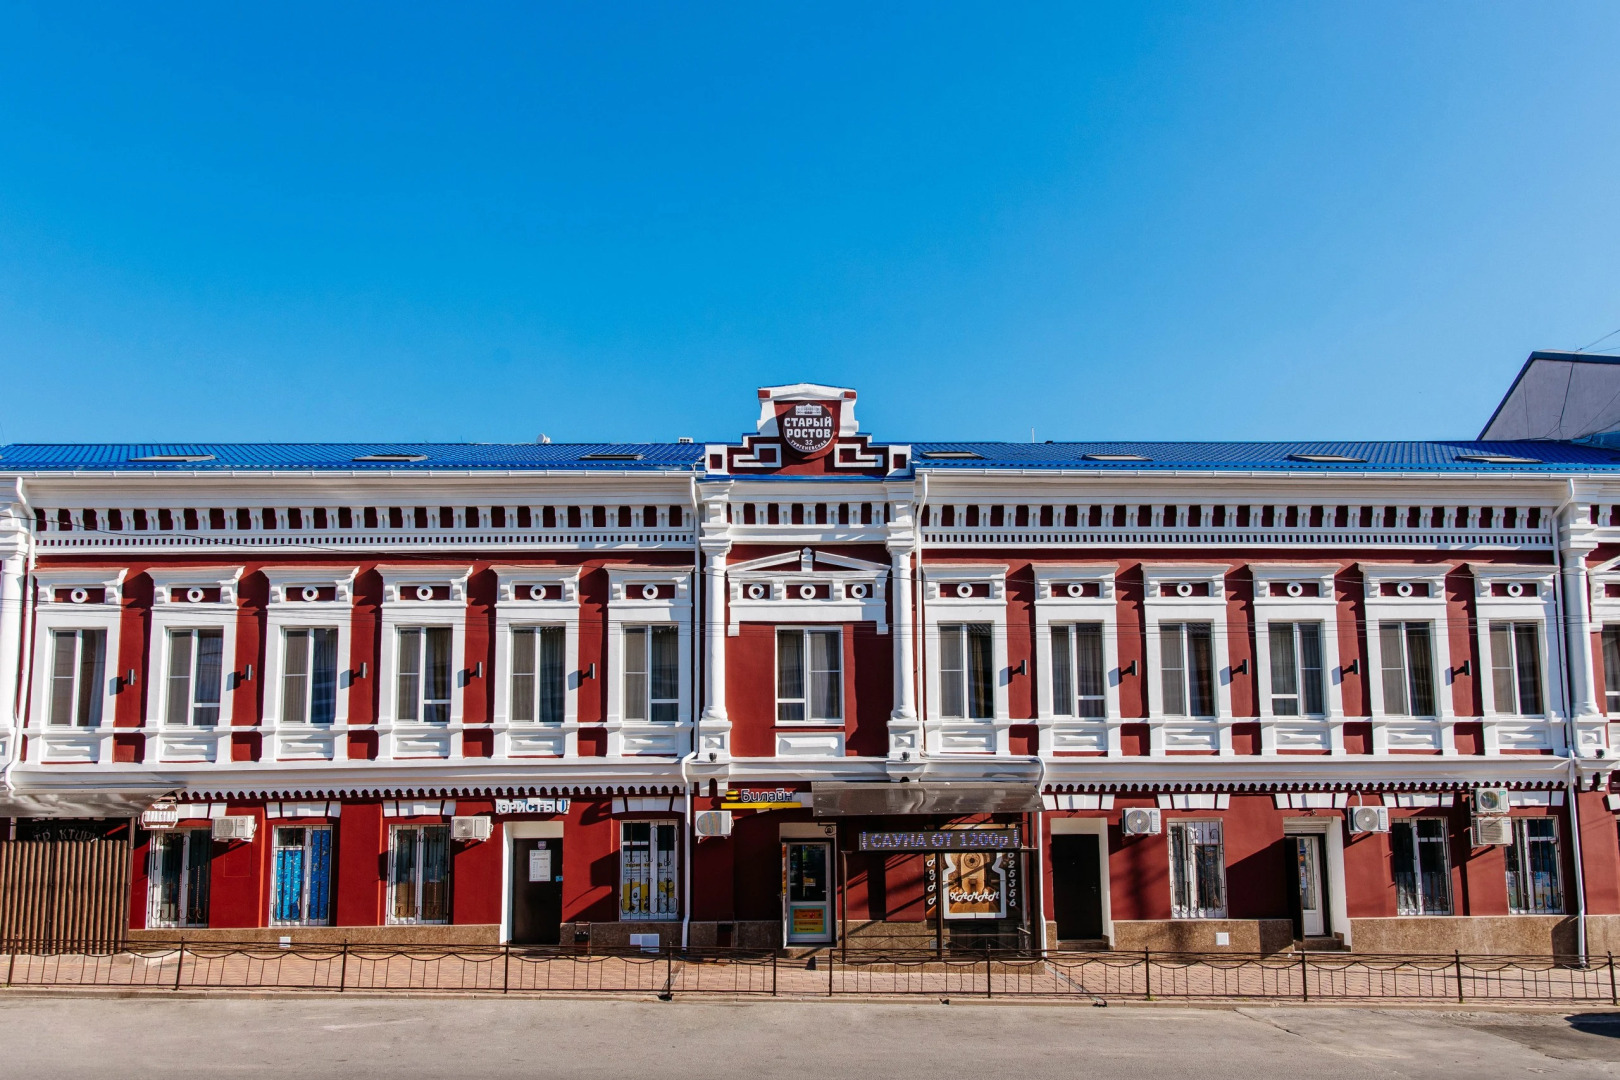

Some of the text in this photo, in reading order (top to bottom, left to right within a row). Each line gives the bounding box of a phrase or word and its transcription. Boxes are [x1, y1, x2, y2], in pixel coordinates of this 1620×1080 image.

[784, 416, 832, 427] СТАРЫЙ
[786, 428, 831, 438] РОСТОВ
[790, 439, 827, 451] ТУРГЕНЕВСКАЯ
[495, 800, 555, 813] ЮРИСТЫ
[870, 833, 927, 847] САУНА
[931, 832, 953, 847] ОТ
[949, 891, 1000, 902] ХАМАМ
